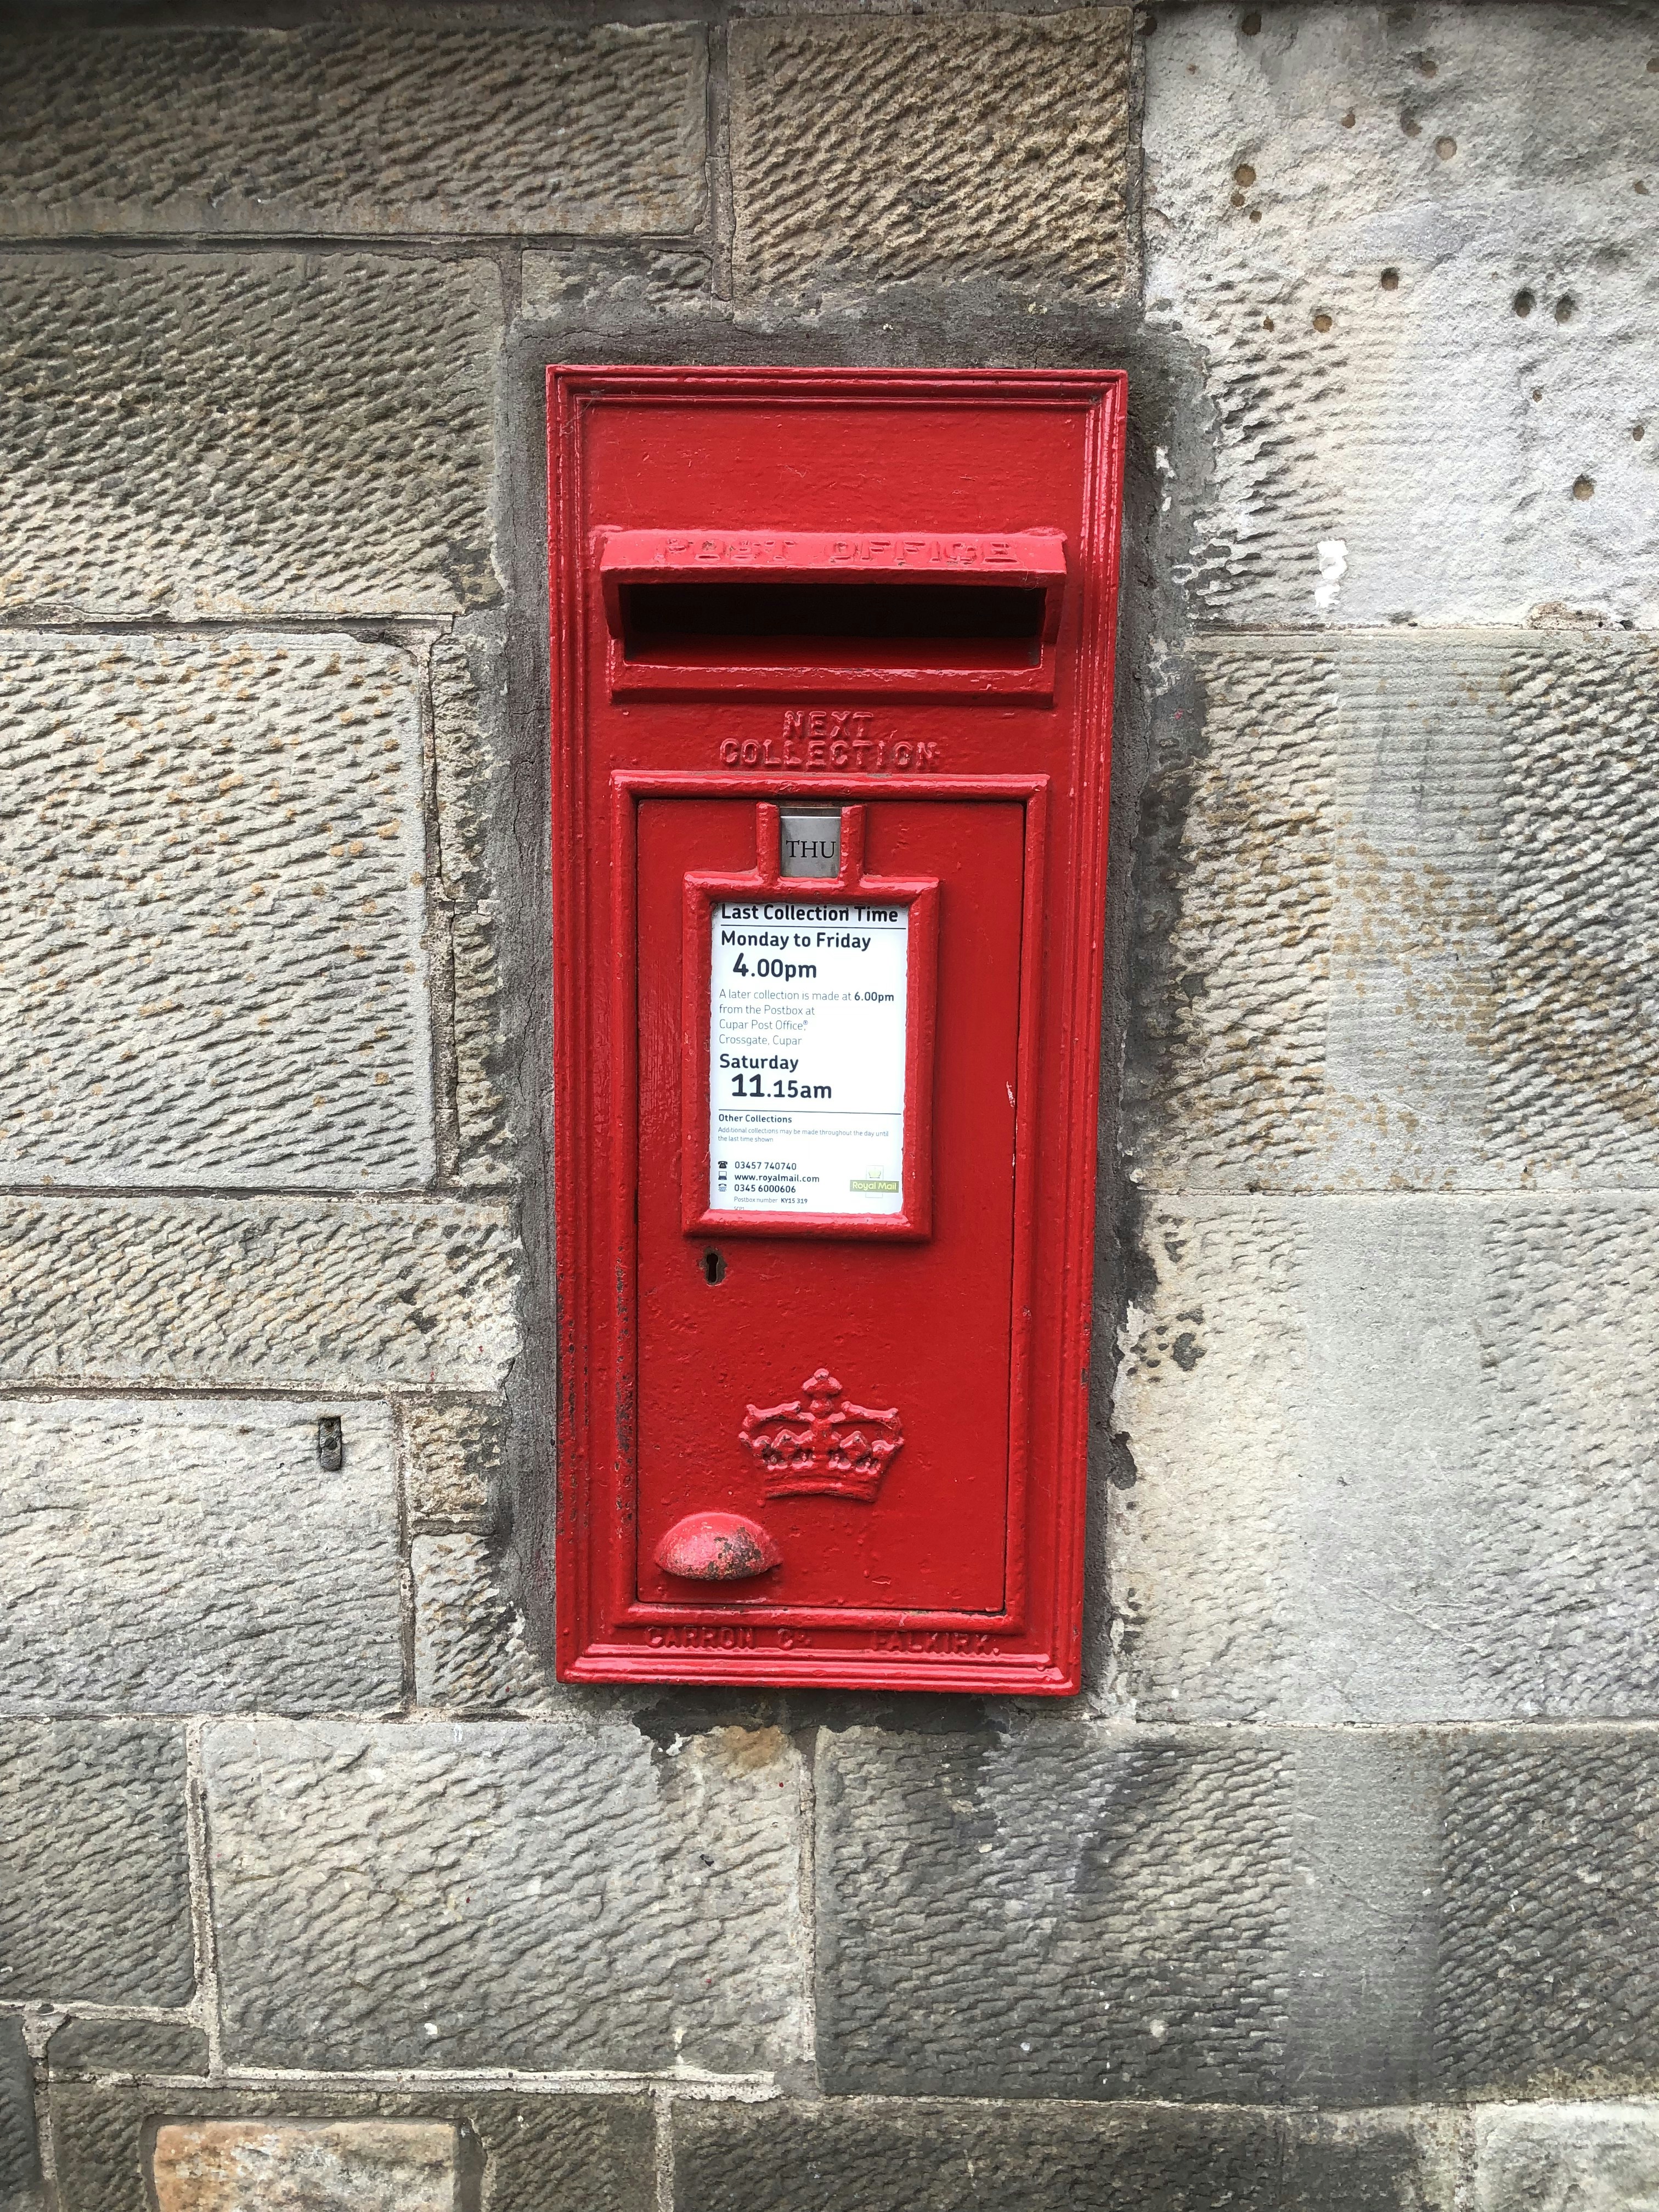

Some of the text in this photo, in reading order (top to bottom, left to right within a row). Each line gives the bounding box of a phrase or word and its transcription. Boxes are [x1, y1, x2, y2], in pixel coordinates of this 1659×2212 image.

[654, 537, 1022, 564] POST OFFICE
[783, 710, 874, 738] NEXT
[719, 738, 938, 768] COLLECTION
[786, 839, 837, 858] THU
[721, 903, 899, 922] Last Collection Time
[721, 930, 871, 952] Monday to Friday
[732, 952, 817, 981] 4.00pm
[719, 989, 895, 1003] A later collection is made at 6.00pm
[719, 1004, 815, 1015] from the Postbox at
[719, 1019, 749, 1031] Cupar
[752, 1019, 773, 1030] Post
[719, 1034, 803, 1047] Crossgate, Cupar
[720, 1053, 799, 1073] Saturday
[731, 1073, 832, 1099] 11.15am
[735, 1174, 820, 1182] www.royalmail.com
[853, 1181, 897, 1191] Royal Mail
[734, 1184, 797, 1193] 0345 6000606
[644, 1626, 755, 1649] CARRON
